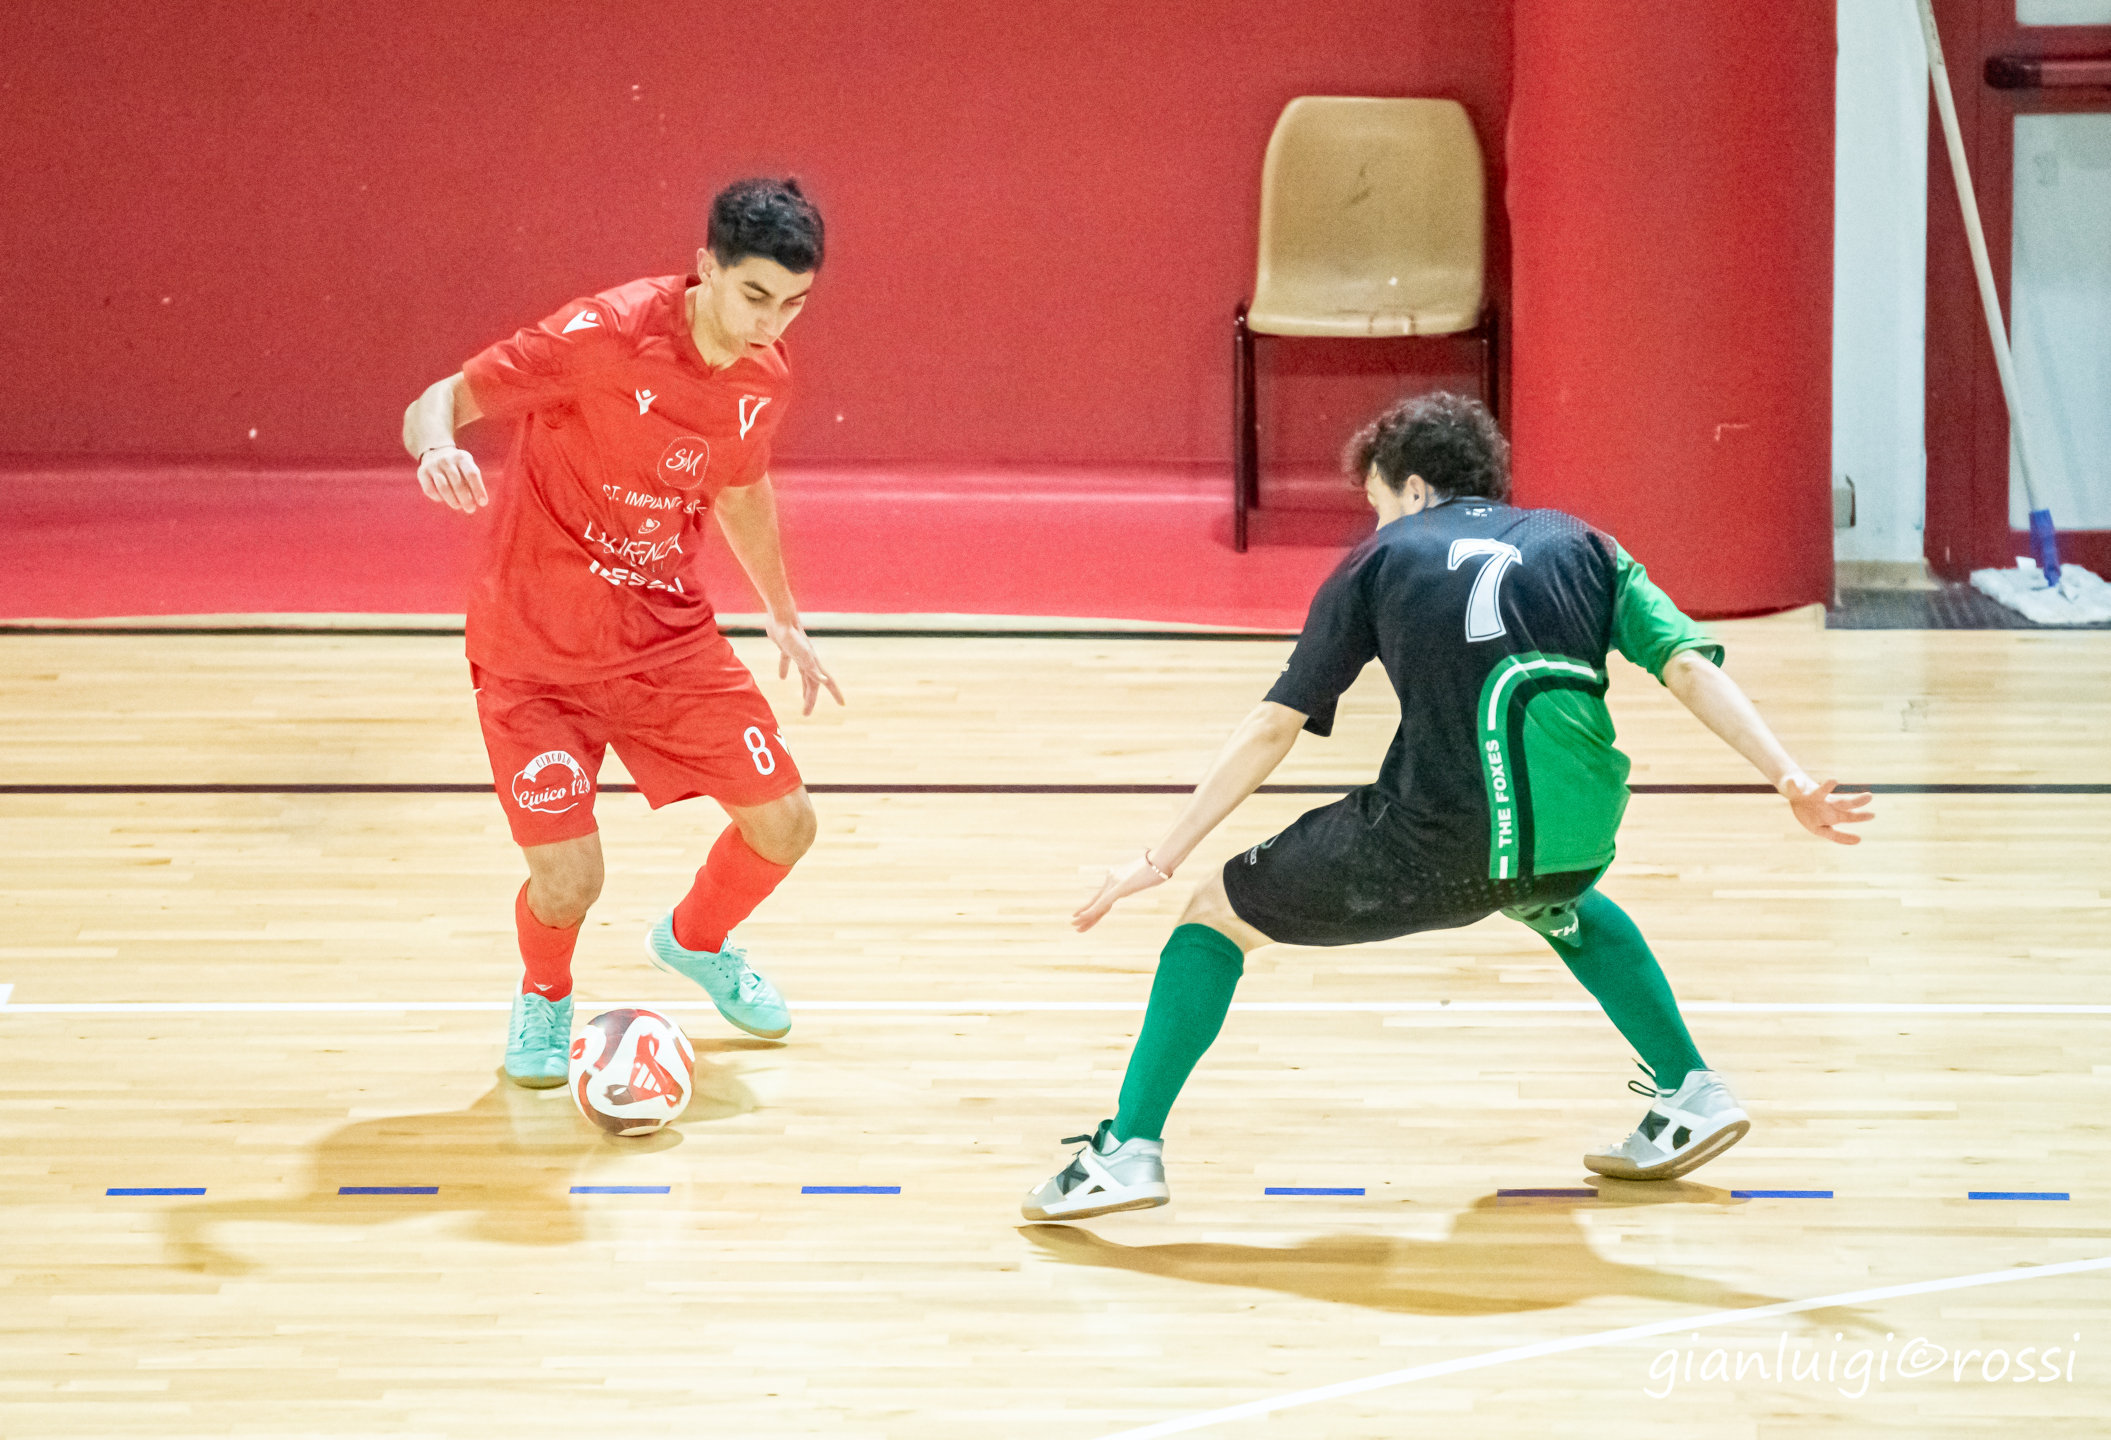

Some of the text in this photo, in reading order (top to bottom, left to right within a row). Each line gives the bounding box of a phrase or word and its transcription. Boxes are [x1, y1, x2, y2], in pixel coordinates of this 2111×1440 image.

[1447, 538, 1523, 643] 7
[535, 752, 572, 769] CIRCOLO
[743, 725, 776, 776] 8
[518, 787, 567, 809] Civico
[1485, 739, 1513, 849] THE FOXES
